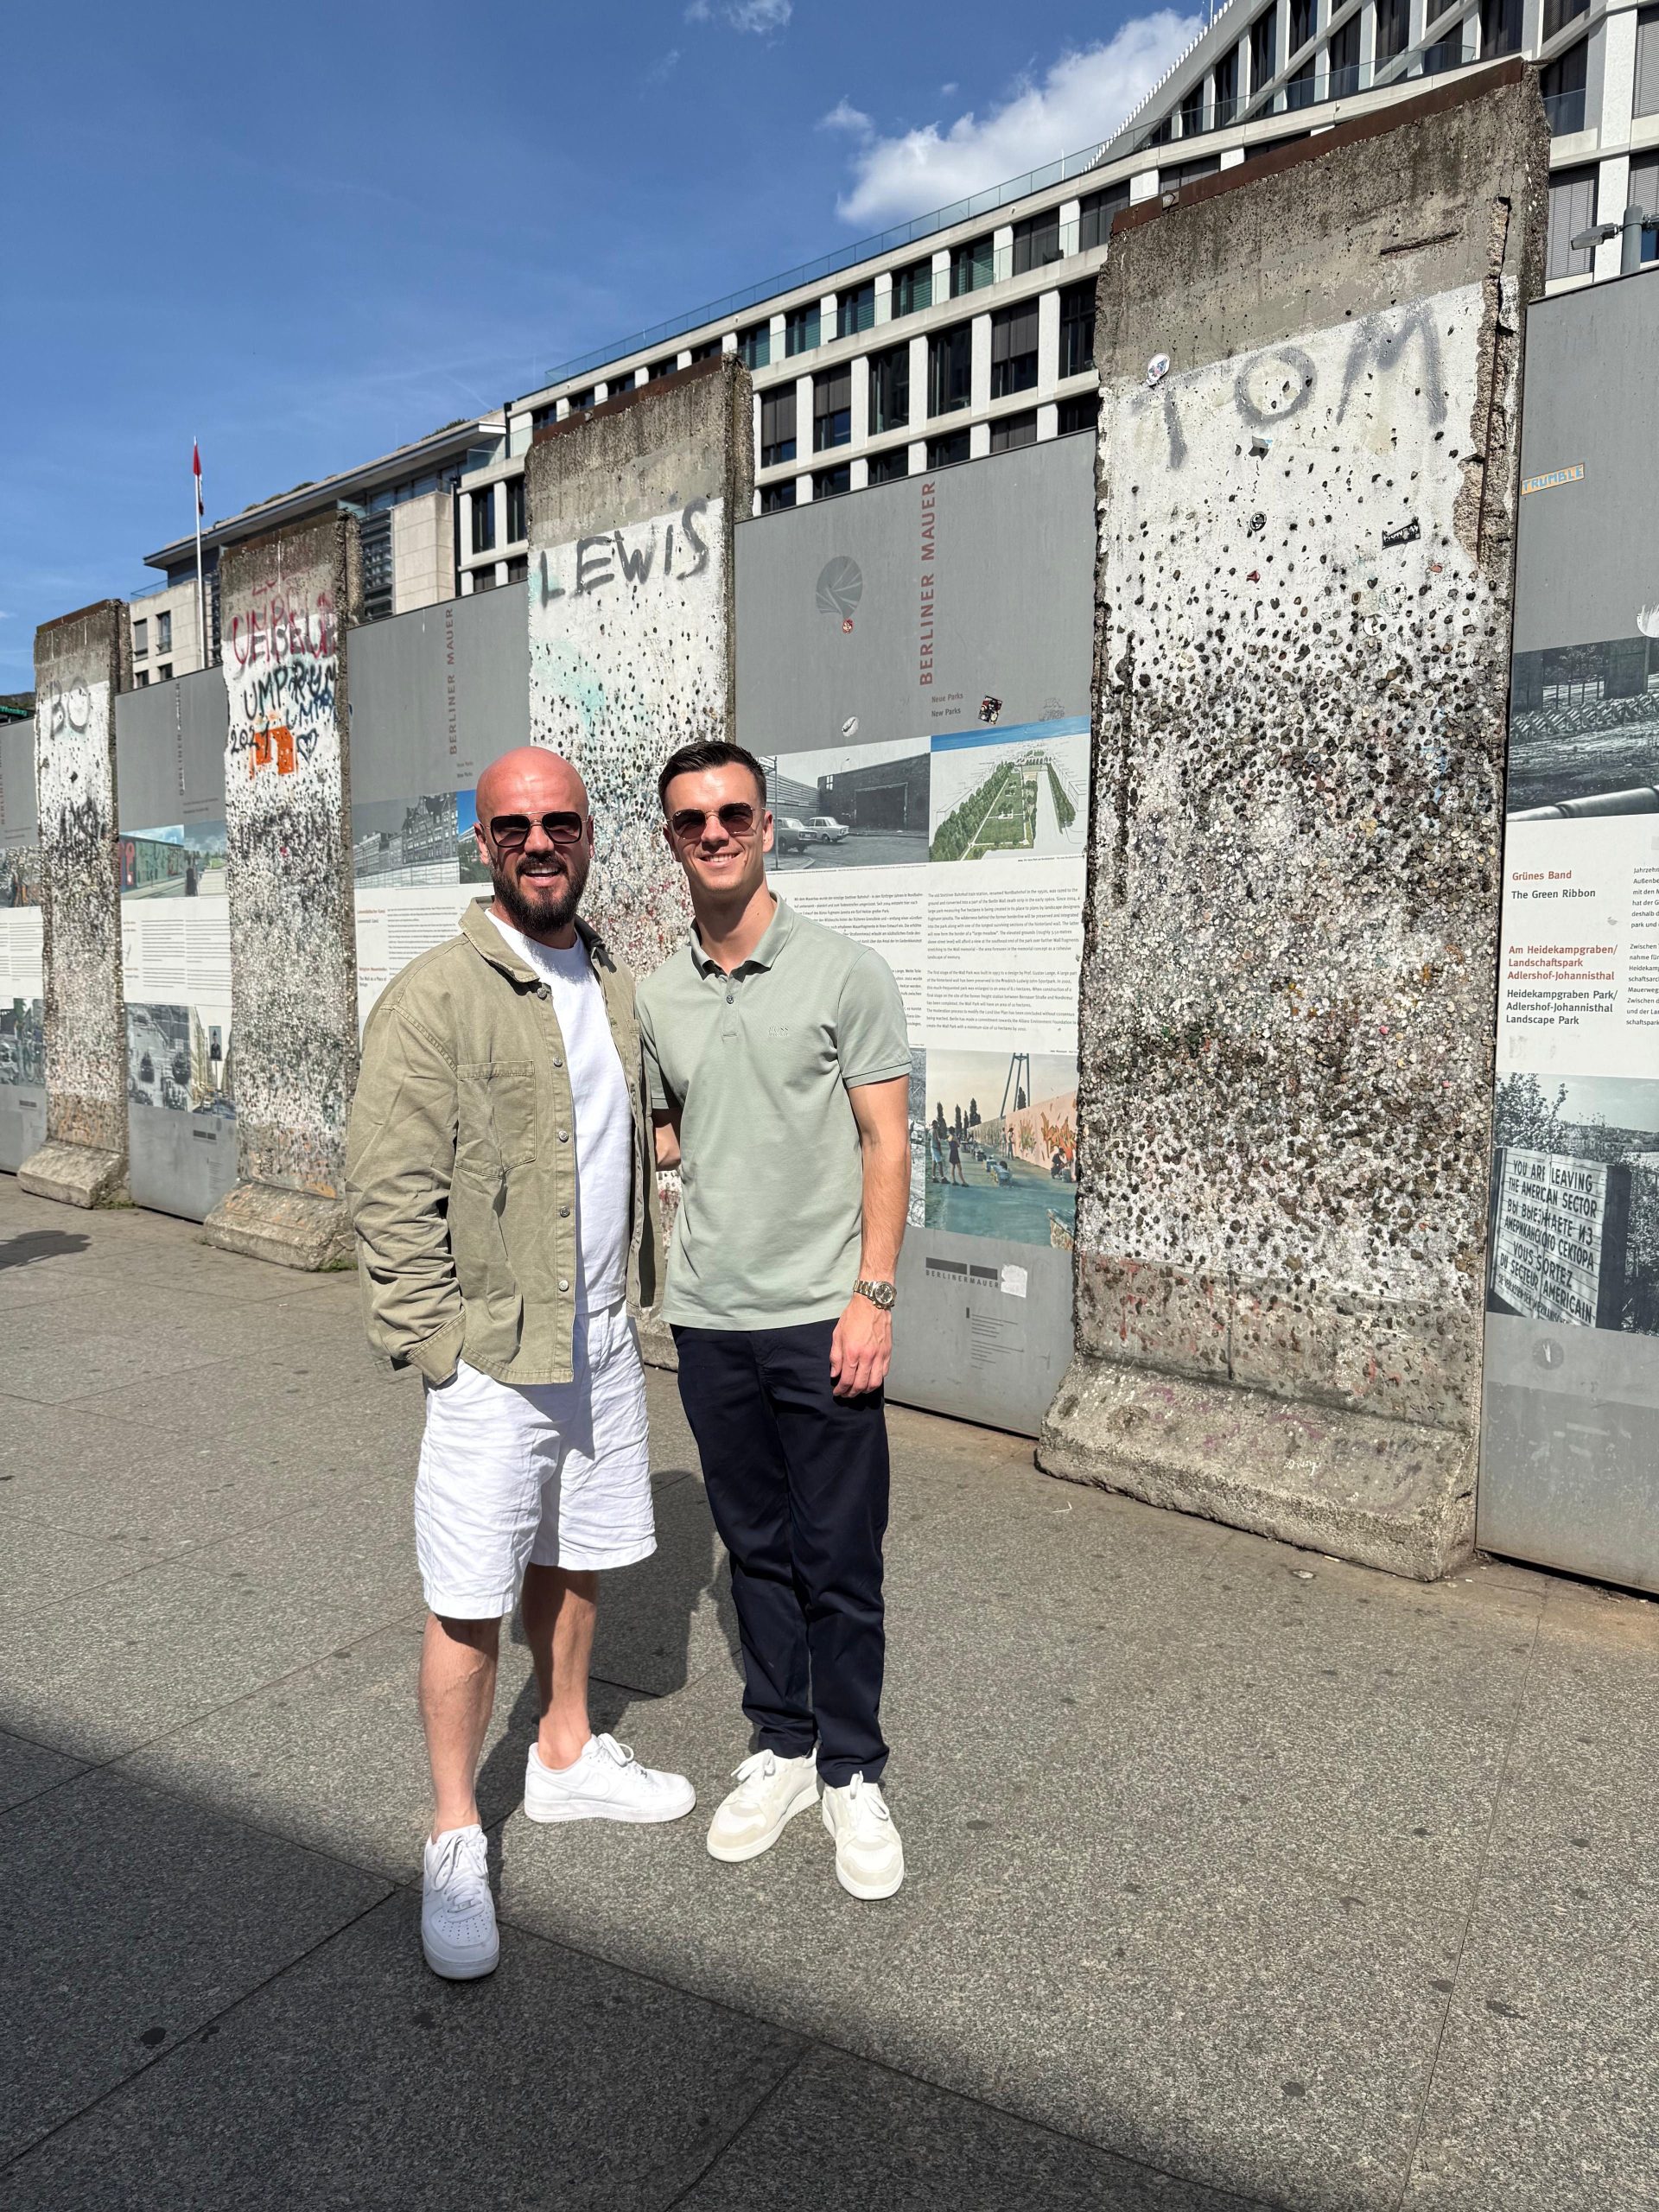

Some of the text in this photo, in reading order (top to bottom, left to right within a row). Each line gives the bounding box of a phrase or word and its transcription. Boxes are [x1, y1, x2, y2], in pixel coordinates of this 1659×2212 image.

[541, 497, 711, 607] LEWIS
[919, 480, 936, 686] BERLINER MAUER
[446, 608, 457, 755] BERLINER MAUER
[947, 692, 963, 702] Parks
[944, 707, 961, 715] Parks
[1512, 870, 1572, 880] Grünes Band
[1512, 889, 1596, 899] The Green Ribbon
[1509, 944, 1618, 956] Am Heidekampgraben/
[1509, 958, 1583, 969] Landschaftspark
[1507, 971, 1615, 981] Adlershof-Johannisthal
[1507, 989, 1618, 1001] Heidekampgraben Park/
[1506, 1002, 1613, 1013] Adlershof-Johannisthal
[1506, 1015, 1580, 1026] Landscape Park
[1514, 1160, 1592, 1192] YOU ARE LEAVING
[1509, 1177, 1597, 1218] THE AMERICAN SECTOR
[1514, 1241, 1573, 1288] VOUS SORTEZ
[1500, 1253, 1592, 1323] DU SECTEUR AMERICAIN
